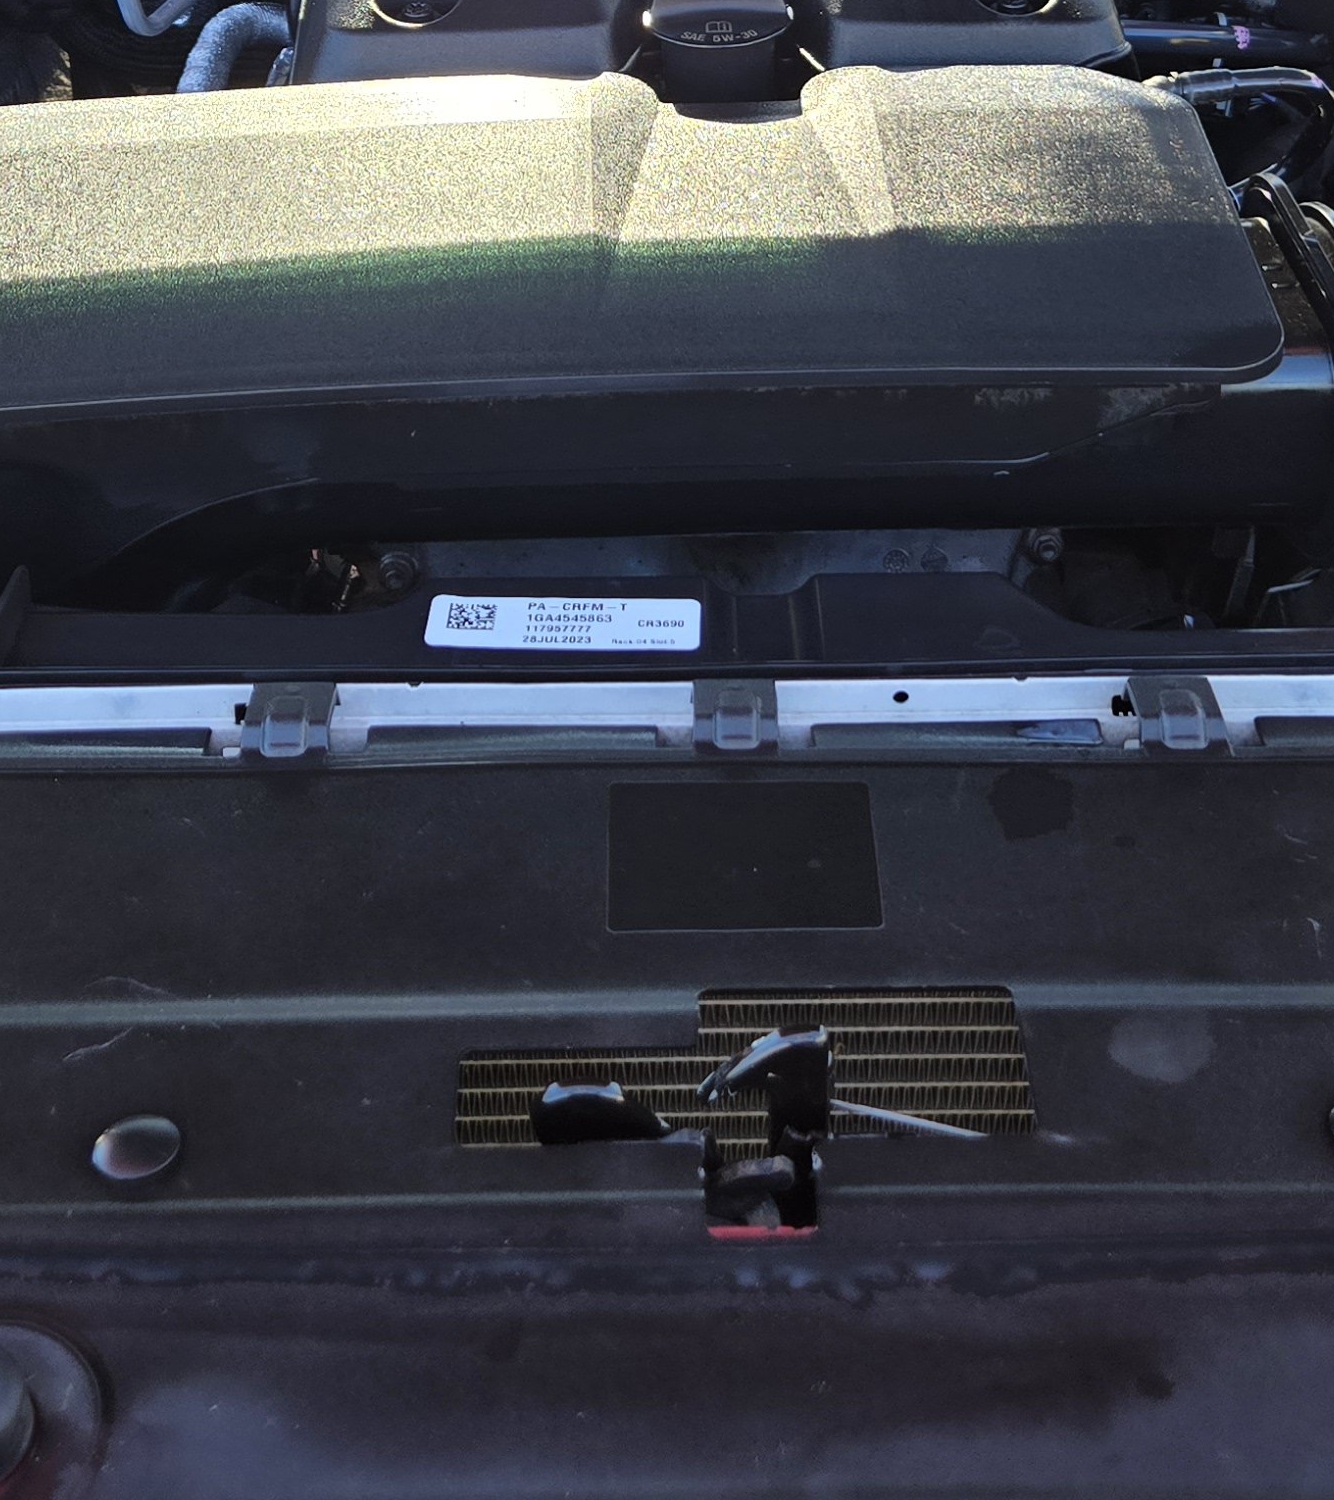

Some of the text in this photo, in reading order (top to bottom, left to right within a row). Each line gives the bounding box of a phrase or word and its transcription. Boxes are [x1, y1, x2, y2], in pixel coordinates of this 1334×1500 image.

[680, 29, 759, 43] SAE 5W-30
[526, 613, 613, 623] 1GA4545863
[637, 619, 685, 628] CR3690
[525, 624, 592, 633] 117957777
[522, 635, 592, 644] 28JUL2023
